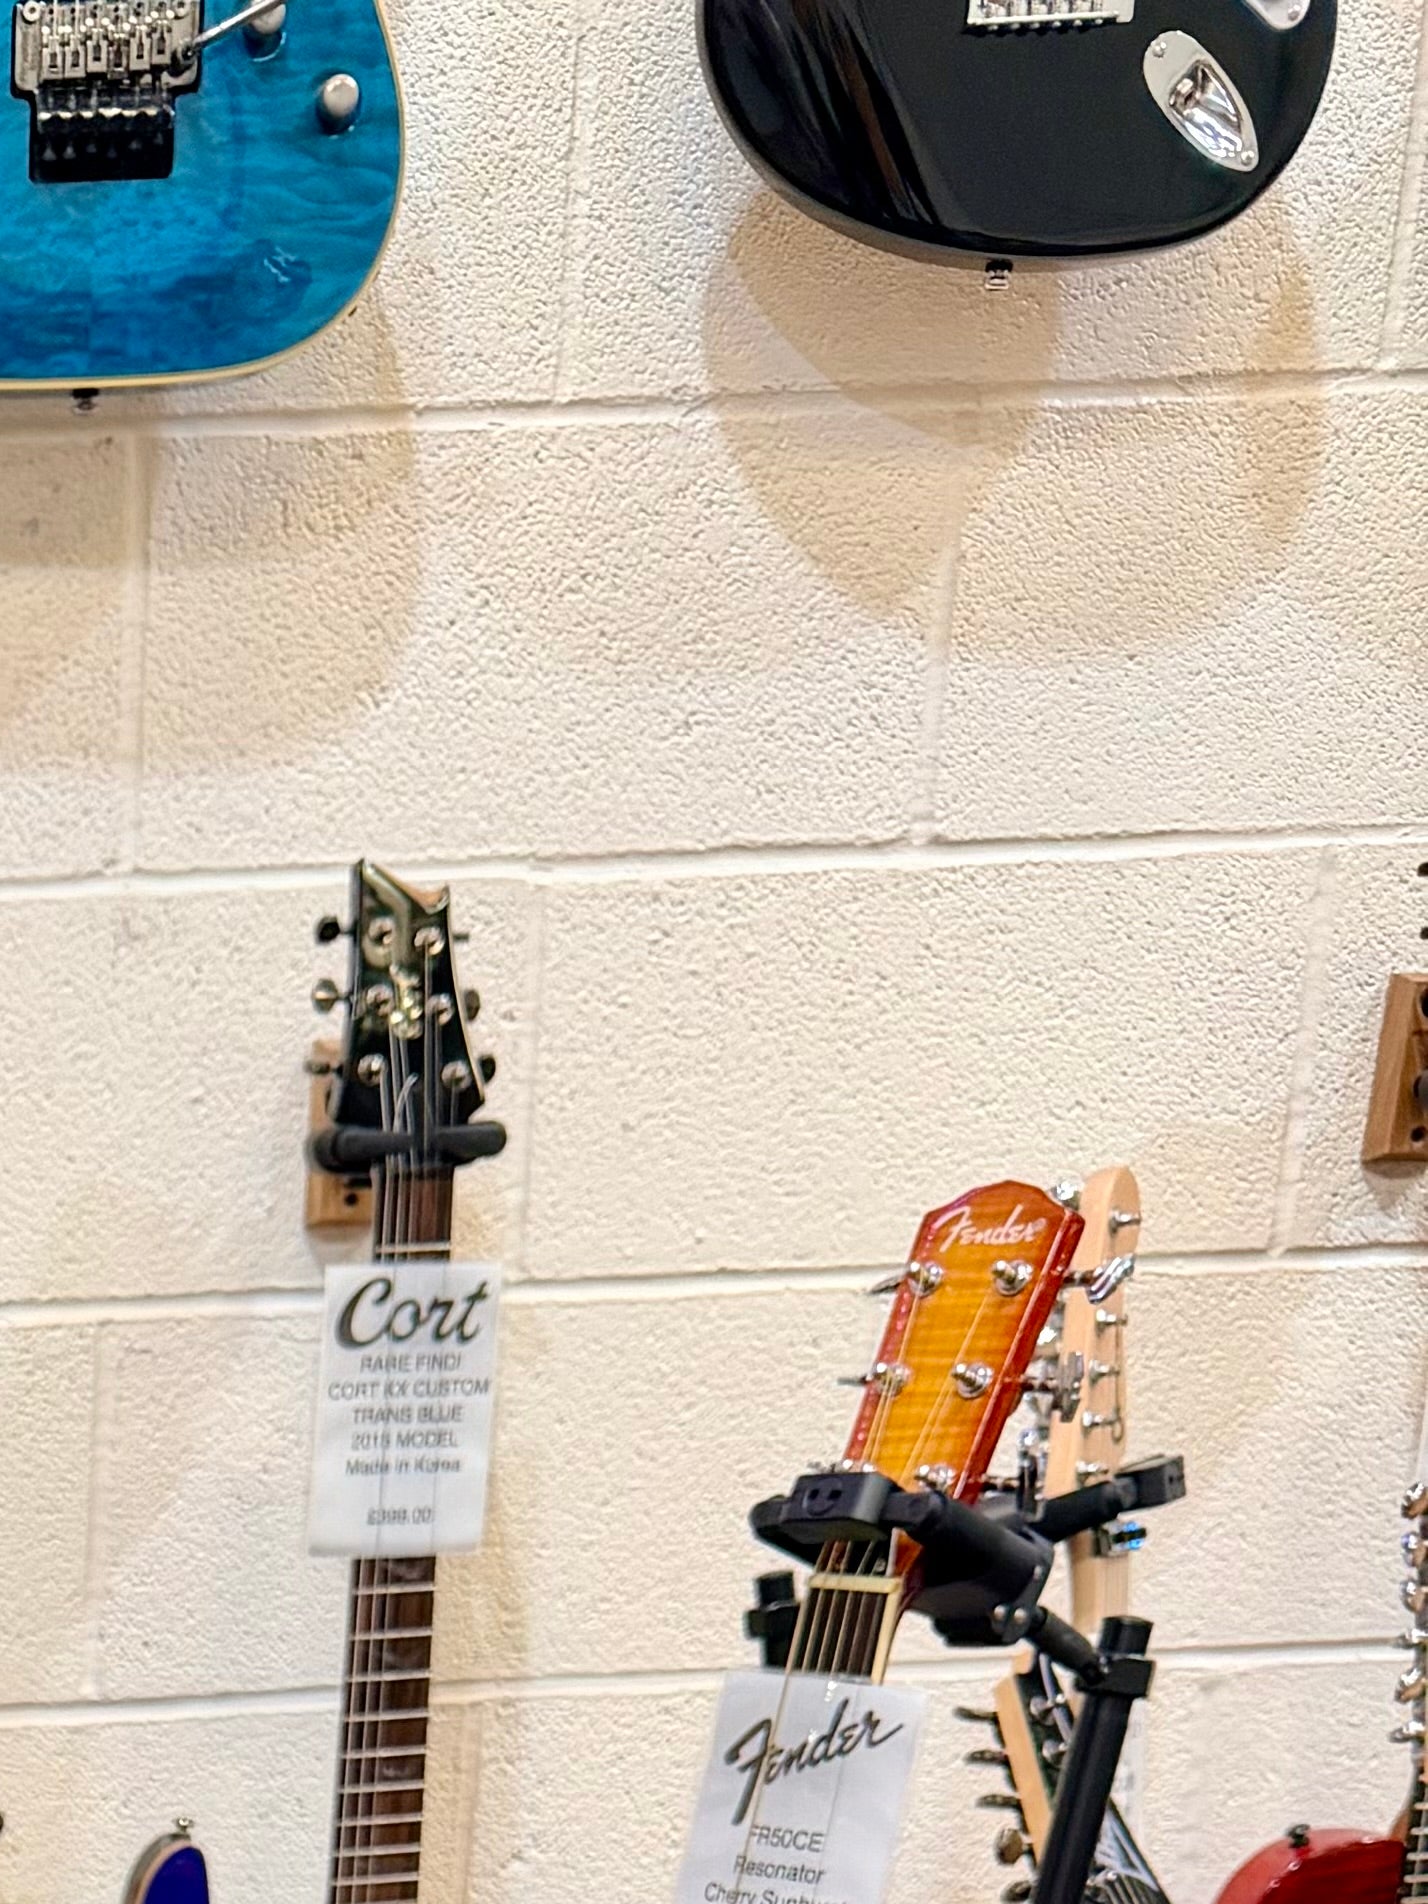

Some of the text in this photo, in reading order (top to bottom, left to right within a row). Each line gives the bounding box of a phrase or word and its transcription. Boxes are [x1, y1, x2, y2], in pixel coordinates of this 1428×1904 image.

[931, 1204, 1047, 1253] Fender
[335, 1277, 488, 1348] Cort
[724, 1697, 904, 1827] Fender
[733, 1855, 827, 1885] Resonator
